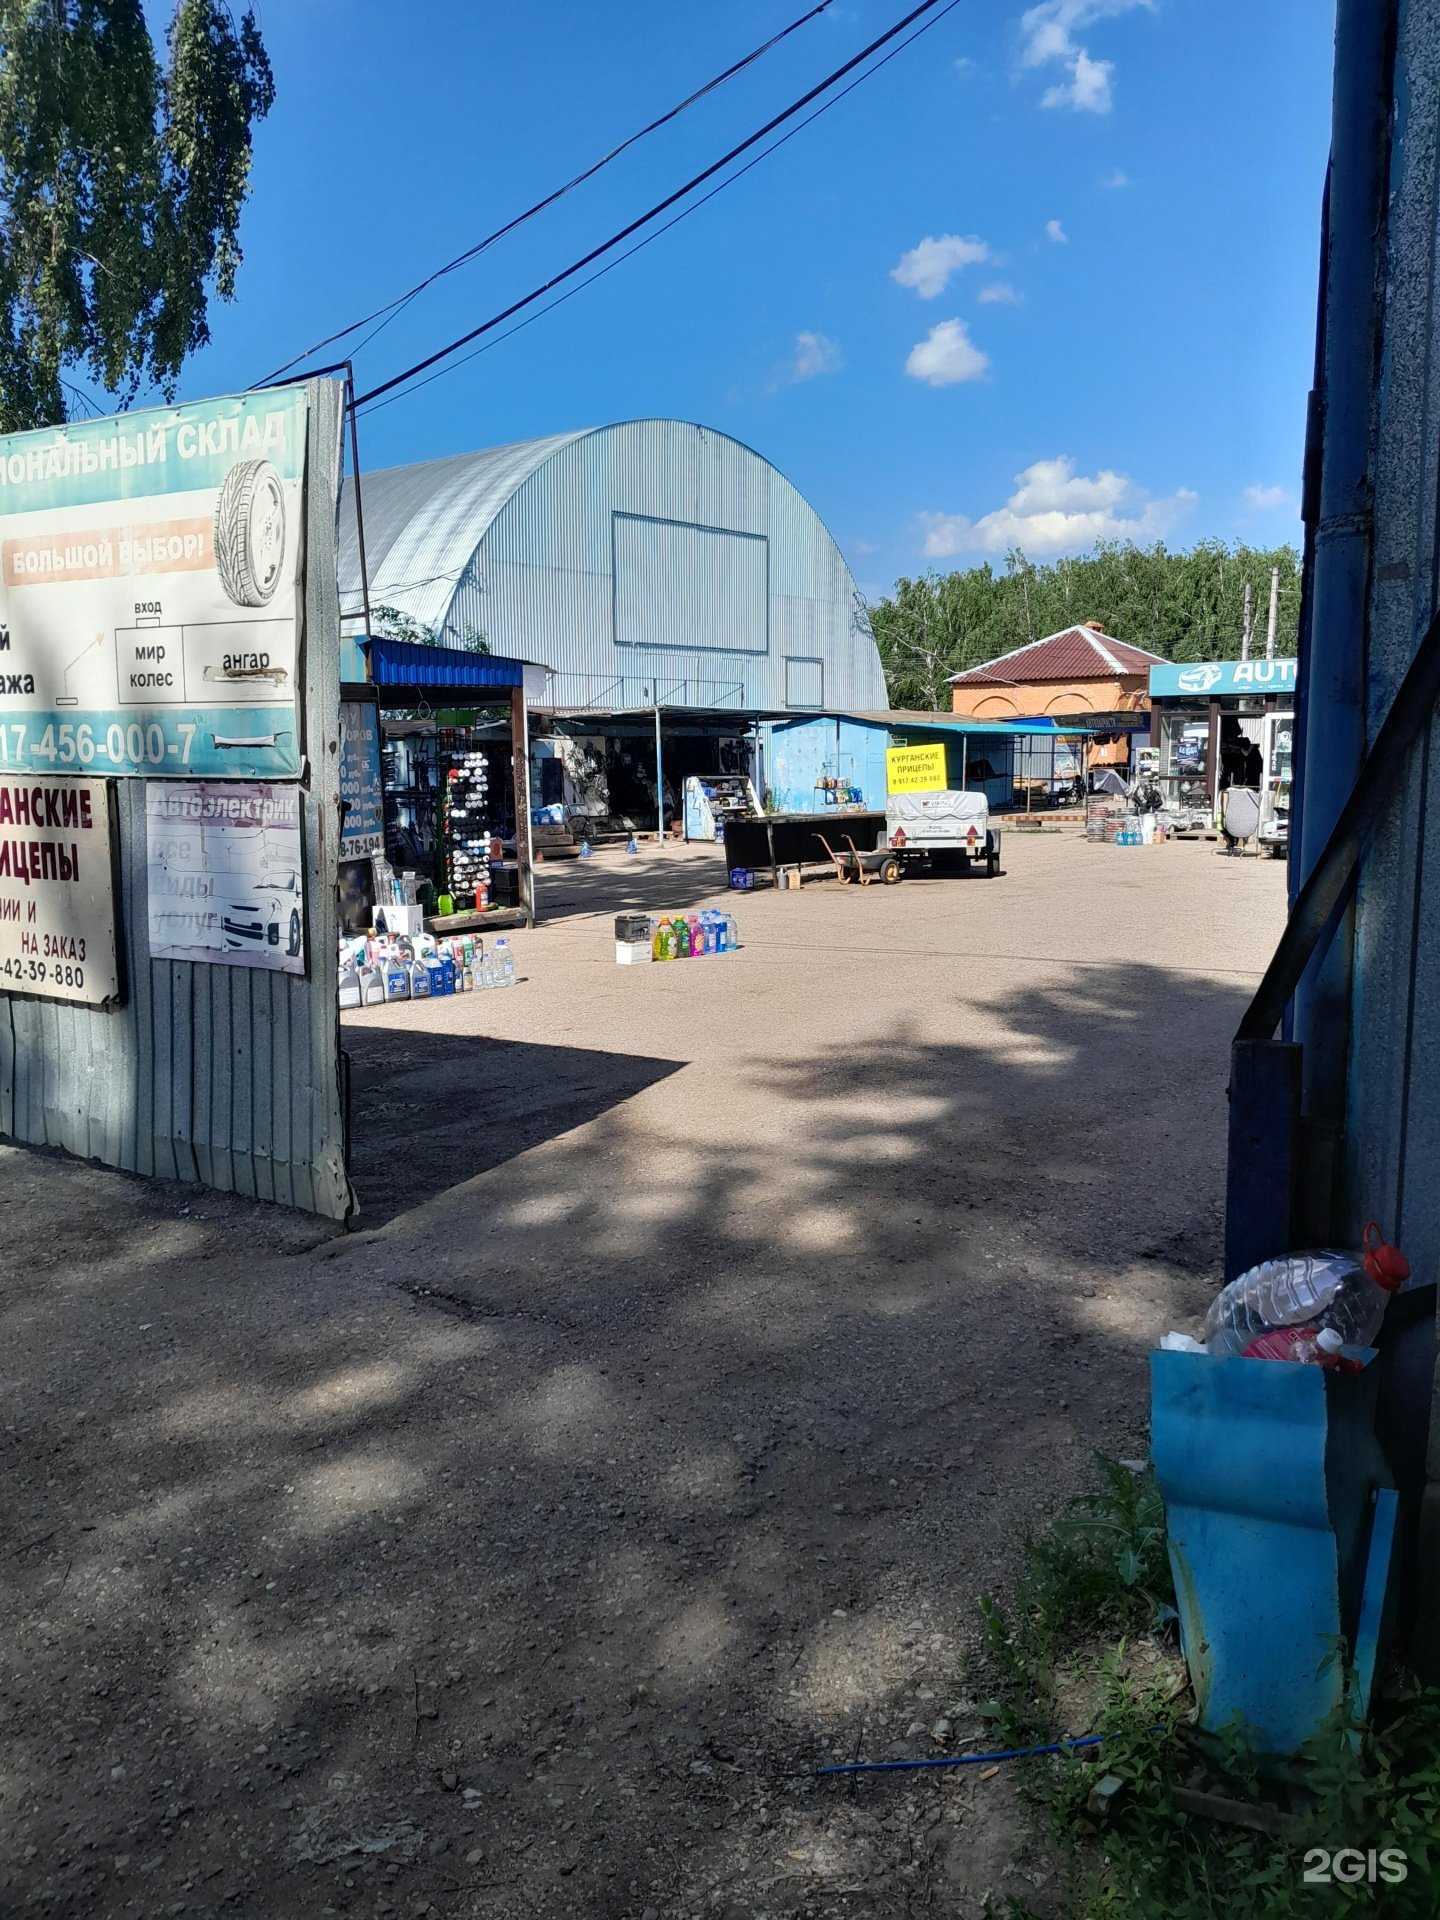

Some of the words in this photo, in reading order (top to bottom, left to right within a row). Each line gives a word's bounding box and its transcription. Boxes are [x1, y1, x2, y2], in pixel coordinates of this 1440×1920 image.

[178, 412, 287, 458] СКЛАД
[13, 539, 114, 575] БОЛЬШОЙ
[119, 533, 204, 568] ВЫБОР!
[134, 600, 163, 615] вход
[135, 643, 166, 665] мир
[222, 651, 270, 672] ангар
[129, 671, 173, 689] колес
[891, 752, 940, 763] КУРГАНСКИЕ
[897, 763, 935, 774] ПРИЦЕПЫ
[0, 787, 93, 829] АНСКИЕ
[156, 788, 295, 826] Автоэлектрик
[0, 896, 20, 922] ИИ
[22, 931, 39, 956] НА
[44, 934, 86, 962] ЗАКАЗ
